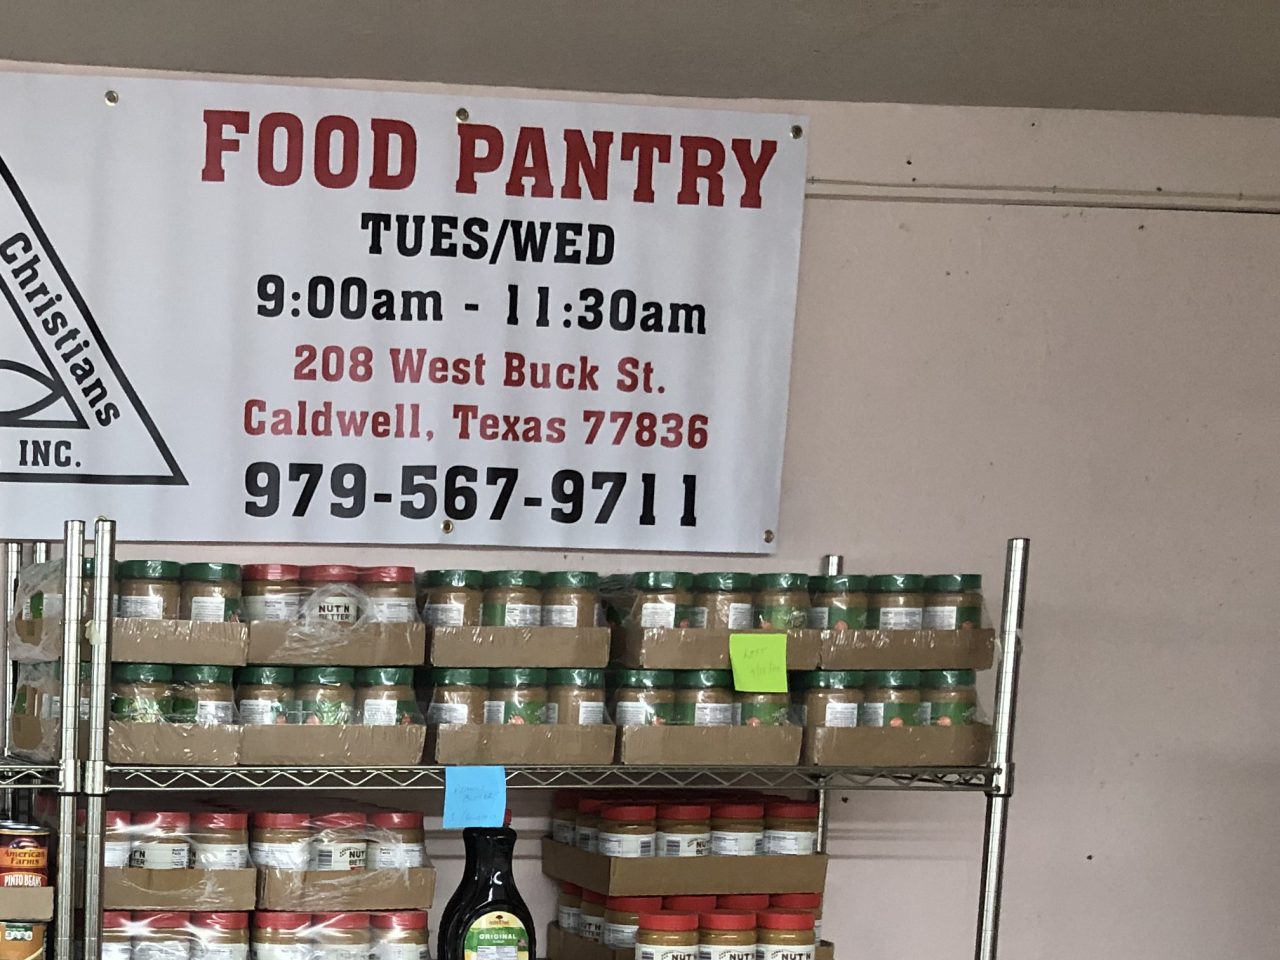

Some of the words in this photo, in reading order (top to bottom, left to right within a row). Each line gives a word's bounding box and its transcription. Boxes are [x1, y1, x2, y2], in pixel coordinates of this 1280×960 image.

[201, 109, 417, 191] FOOD
[455, 122, 778, 209] PANTRY
[361, 212, 616, 265] TUES/WED
[256, 274, 444, 321] 9:00am
[506, 283, 707, 335] 11:30am
[293, 344, 374, 383] 208
[388, 348, 487, 387] West
[502, 352, 600, 392] Buck
[616, 357, 667, 395] St.
[243, 399, 435, 442] Caldwell,
[452, 404, 567, 444] Texas
[582, 411, 710, 450] 77836
[18, 440, 81, 468] INC.
[244, 461, 697, 527] 979-567-9711
[4, 848, 45, 858] American
[10, 857, 40, 865] Farms
[4, 874, 24, 887] PINTO
[24, 873, 41, 887] BEANS
